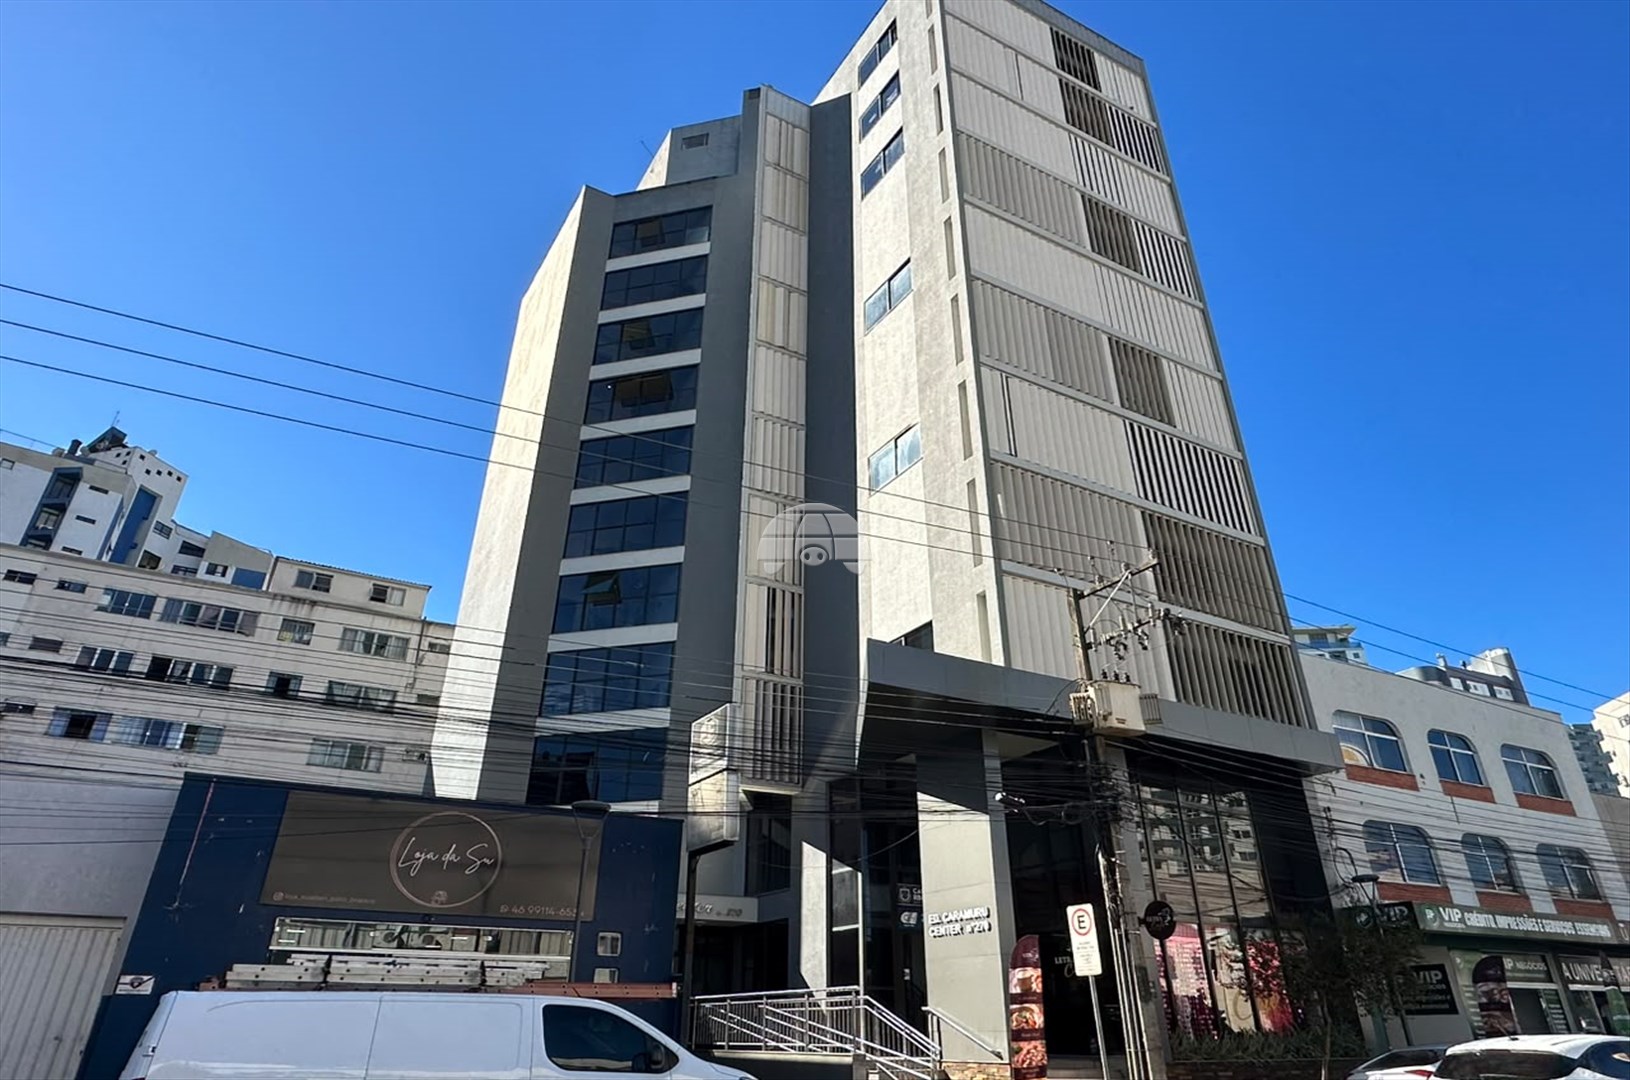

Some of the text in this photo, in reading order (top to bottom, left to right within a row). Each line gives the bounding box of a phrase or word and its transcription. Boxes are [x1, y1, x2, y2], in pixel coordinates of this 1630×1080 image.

[398, 837, 494, 876] Loja da Su
[511, 904, 584, 917] 46 99114-65
[942, 907, 990, 923] CARAMURU
[1439, 907, 1462, 921] VIP
[1077, 915, 1087, 930] E
[929, 924, 964, 938] CENTER
[1562, 963, 1573, 980] A
